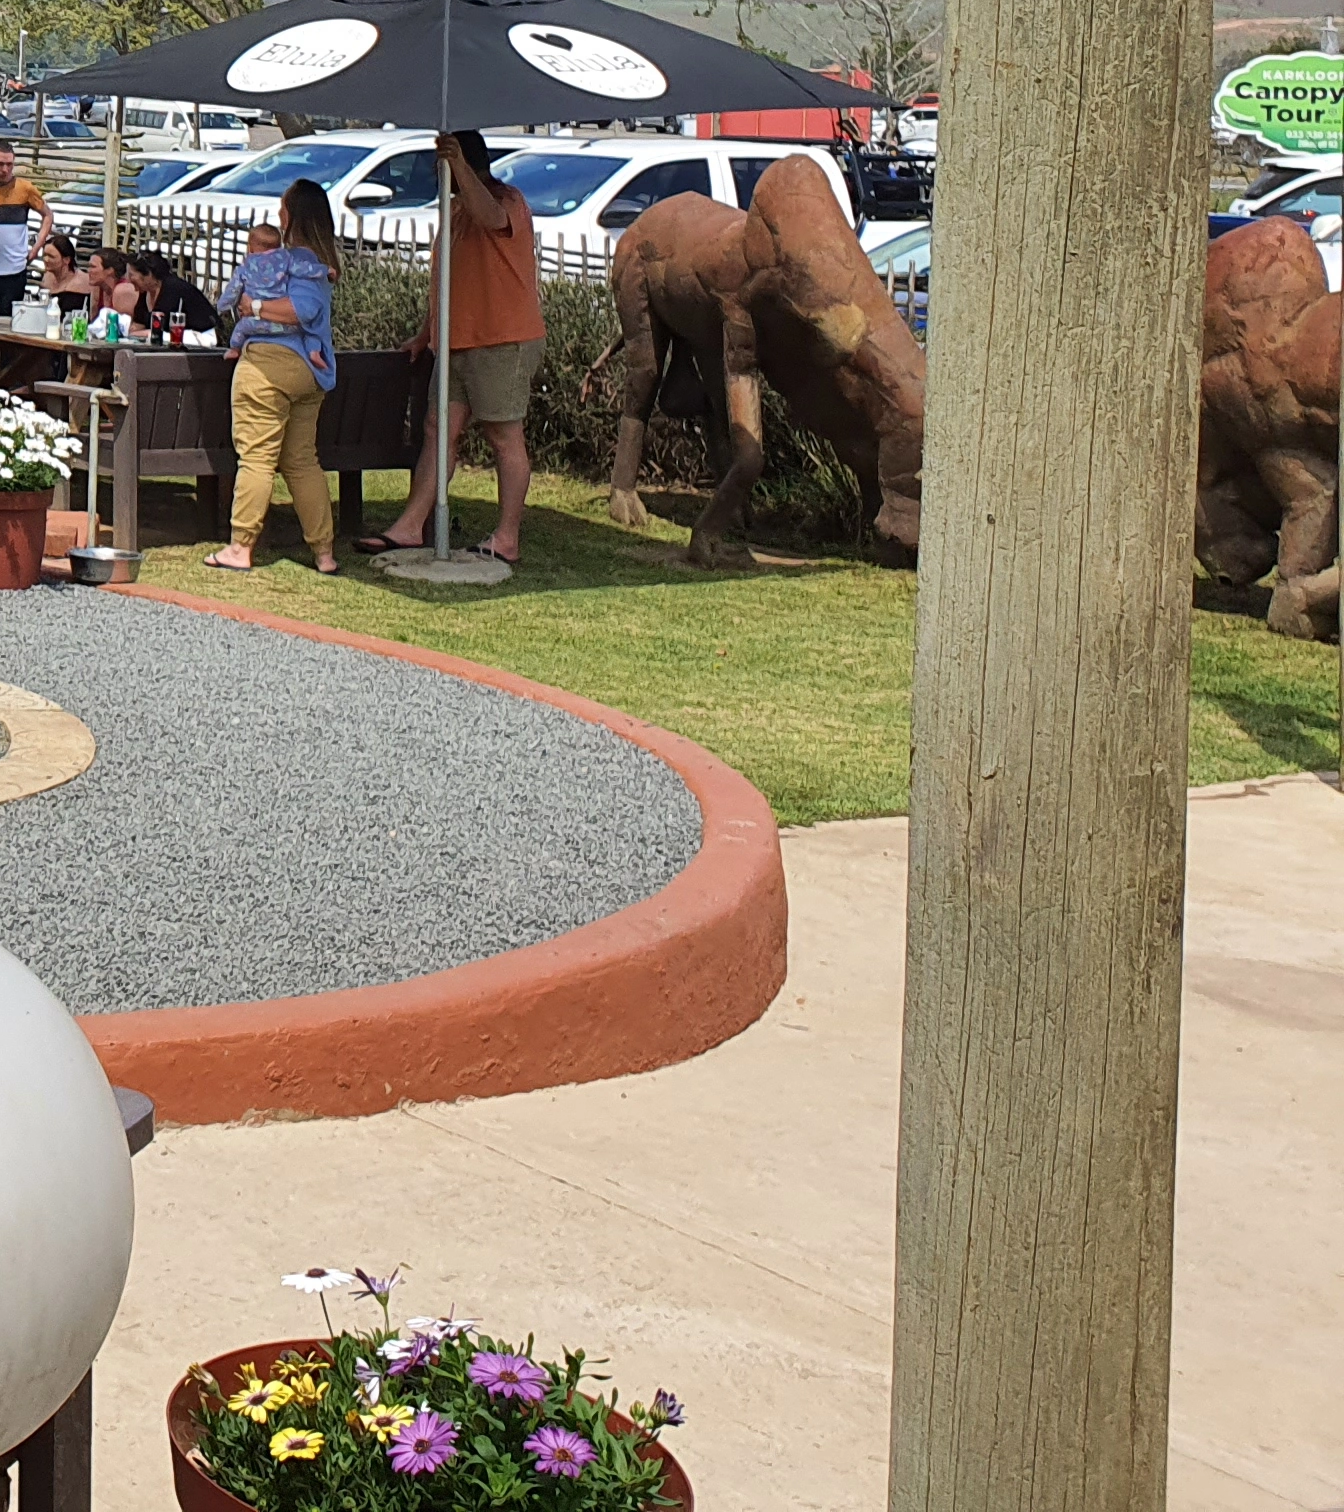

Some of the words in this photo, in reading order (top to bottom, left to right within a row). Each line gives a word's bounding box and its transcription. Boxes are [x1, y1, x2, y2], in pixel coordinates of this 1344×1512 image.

[251, 42, 347, 68] Elula
[533, 53, 646, 73] Elula
[1234, 81, 1344, 105] Canopy
[1260, 104, 1326, 123] Tour
